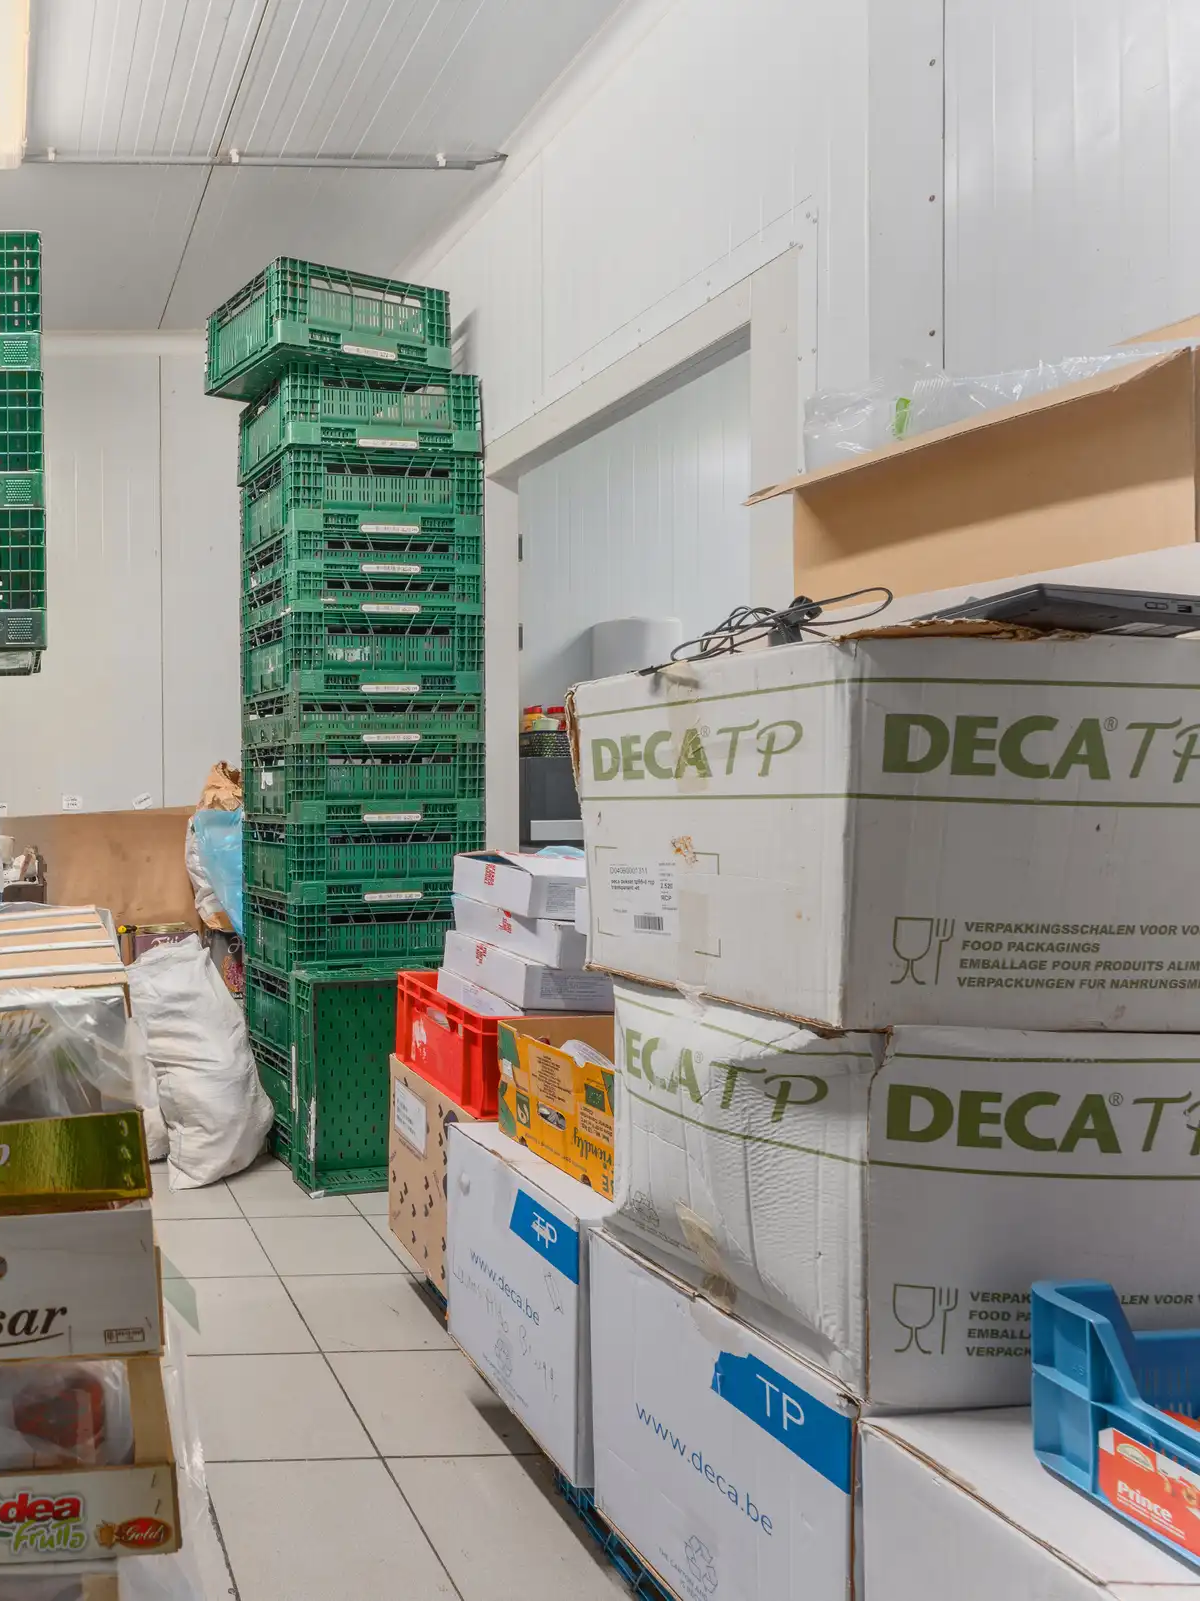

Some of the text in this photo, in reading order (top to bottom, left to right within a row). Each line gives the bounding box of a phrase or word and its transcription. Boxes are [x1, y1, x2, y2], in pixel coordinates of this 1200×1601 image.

[717, 719, 803, 777] TP
[965, 921, 1200, 936] VERPAKKINGSSCHALEN VOOR VO
[961, 940, 1100, 953] FOOD PACKAGINGS
[959, 958, 1048, 970] EMBALLAGE
[1051, 960, 1095, 971] POUR
[1095, 960, 1164, 971] PRODUITS
[957, 976, 1075, 989] VERPACKUNGEN
[709, 1061, 828, 1123] TP
[470, 1248, 541, 1326] www.deca.be
[1154, 1295, 1193, 1305] VOOR
[969, 1310, 1011, 1321] FOOD
[755, 1373, 805, 1431] TP
[635, 1402, 773, 1536] www.deca.be
[1118, 1480, 1173, 1523] Prince
[123, 1524, 164, 1542] Gold
